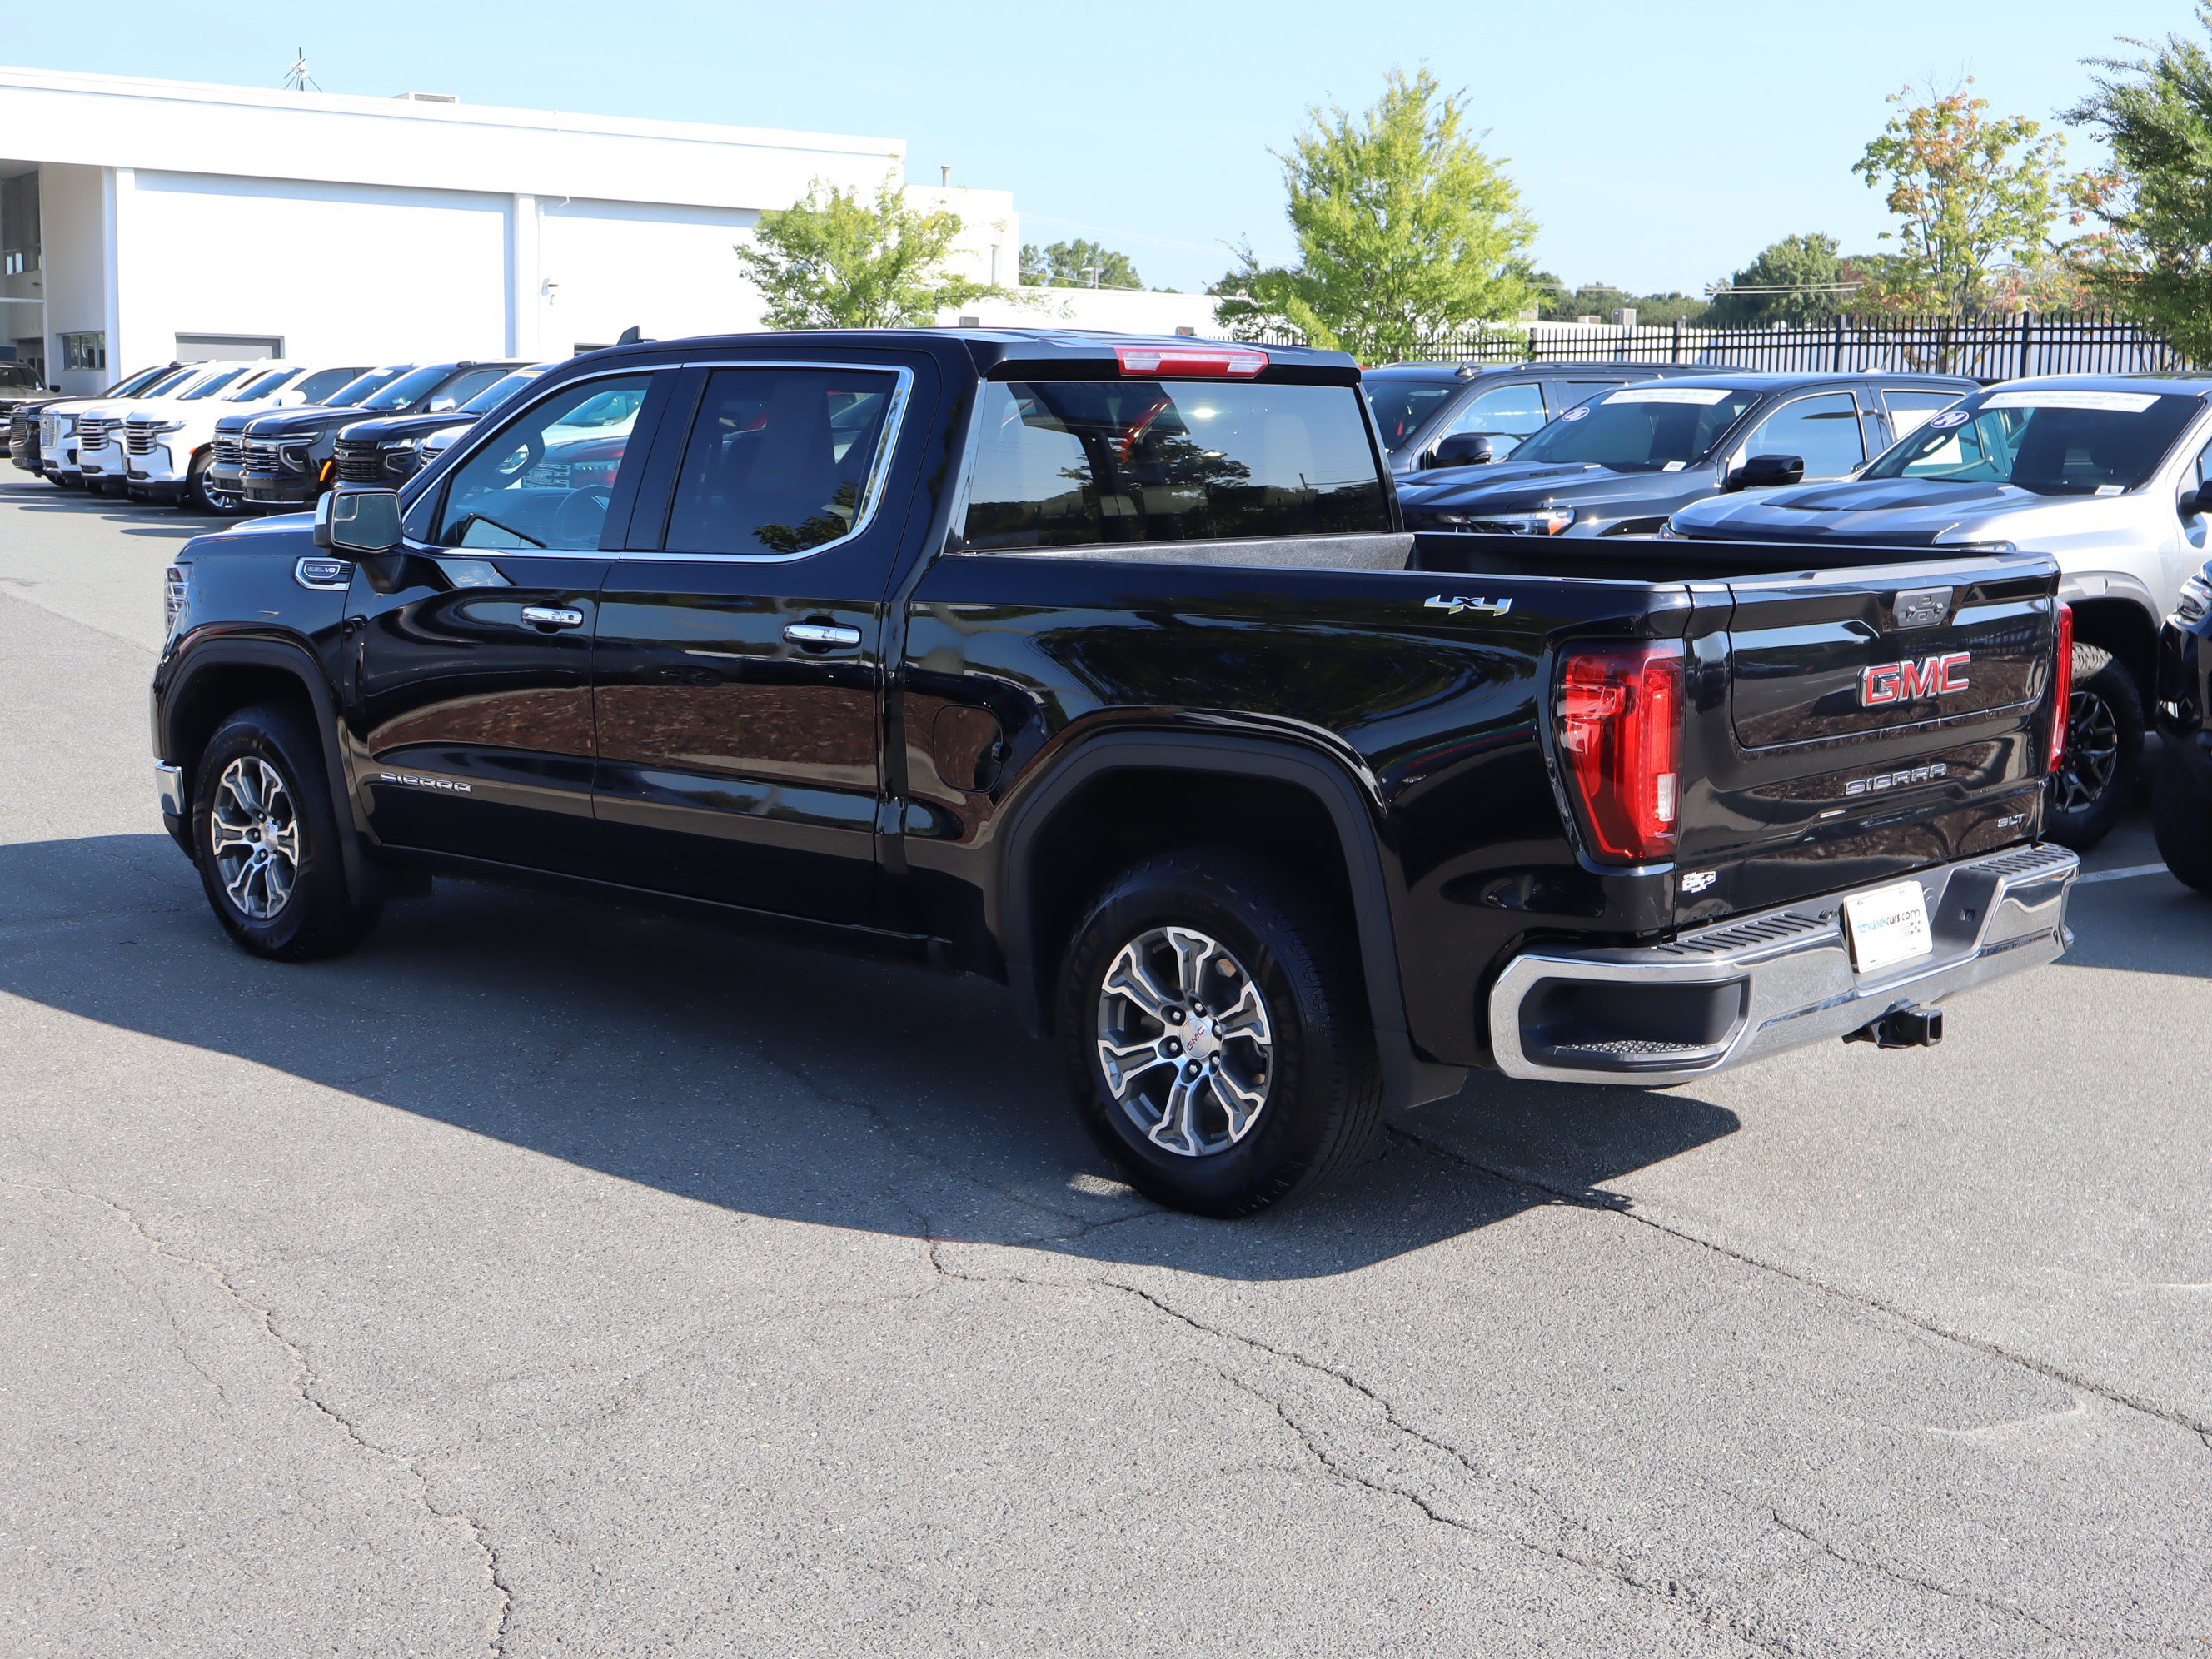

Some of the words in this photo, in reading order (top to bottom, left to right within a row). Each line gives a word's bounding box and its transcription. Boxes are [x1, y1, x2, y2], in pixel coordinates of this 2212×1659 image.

[1858, 650, 1971, 707] GMC
[380, 771, 472, 793] SIERRA
[1844, 763, 1948, 796] SIERRA
[1997, 813, 2027, 828] SLT
[1186, 1025, 1206, 1051] GMC
